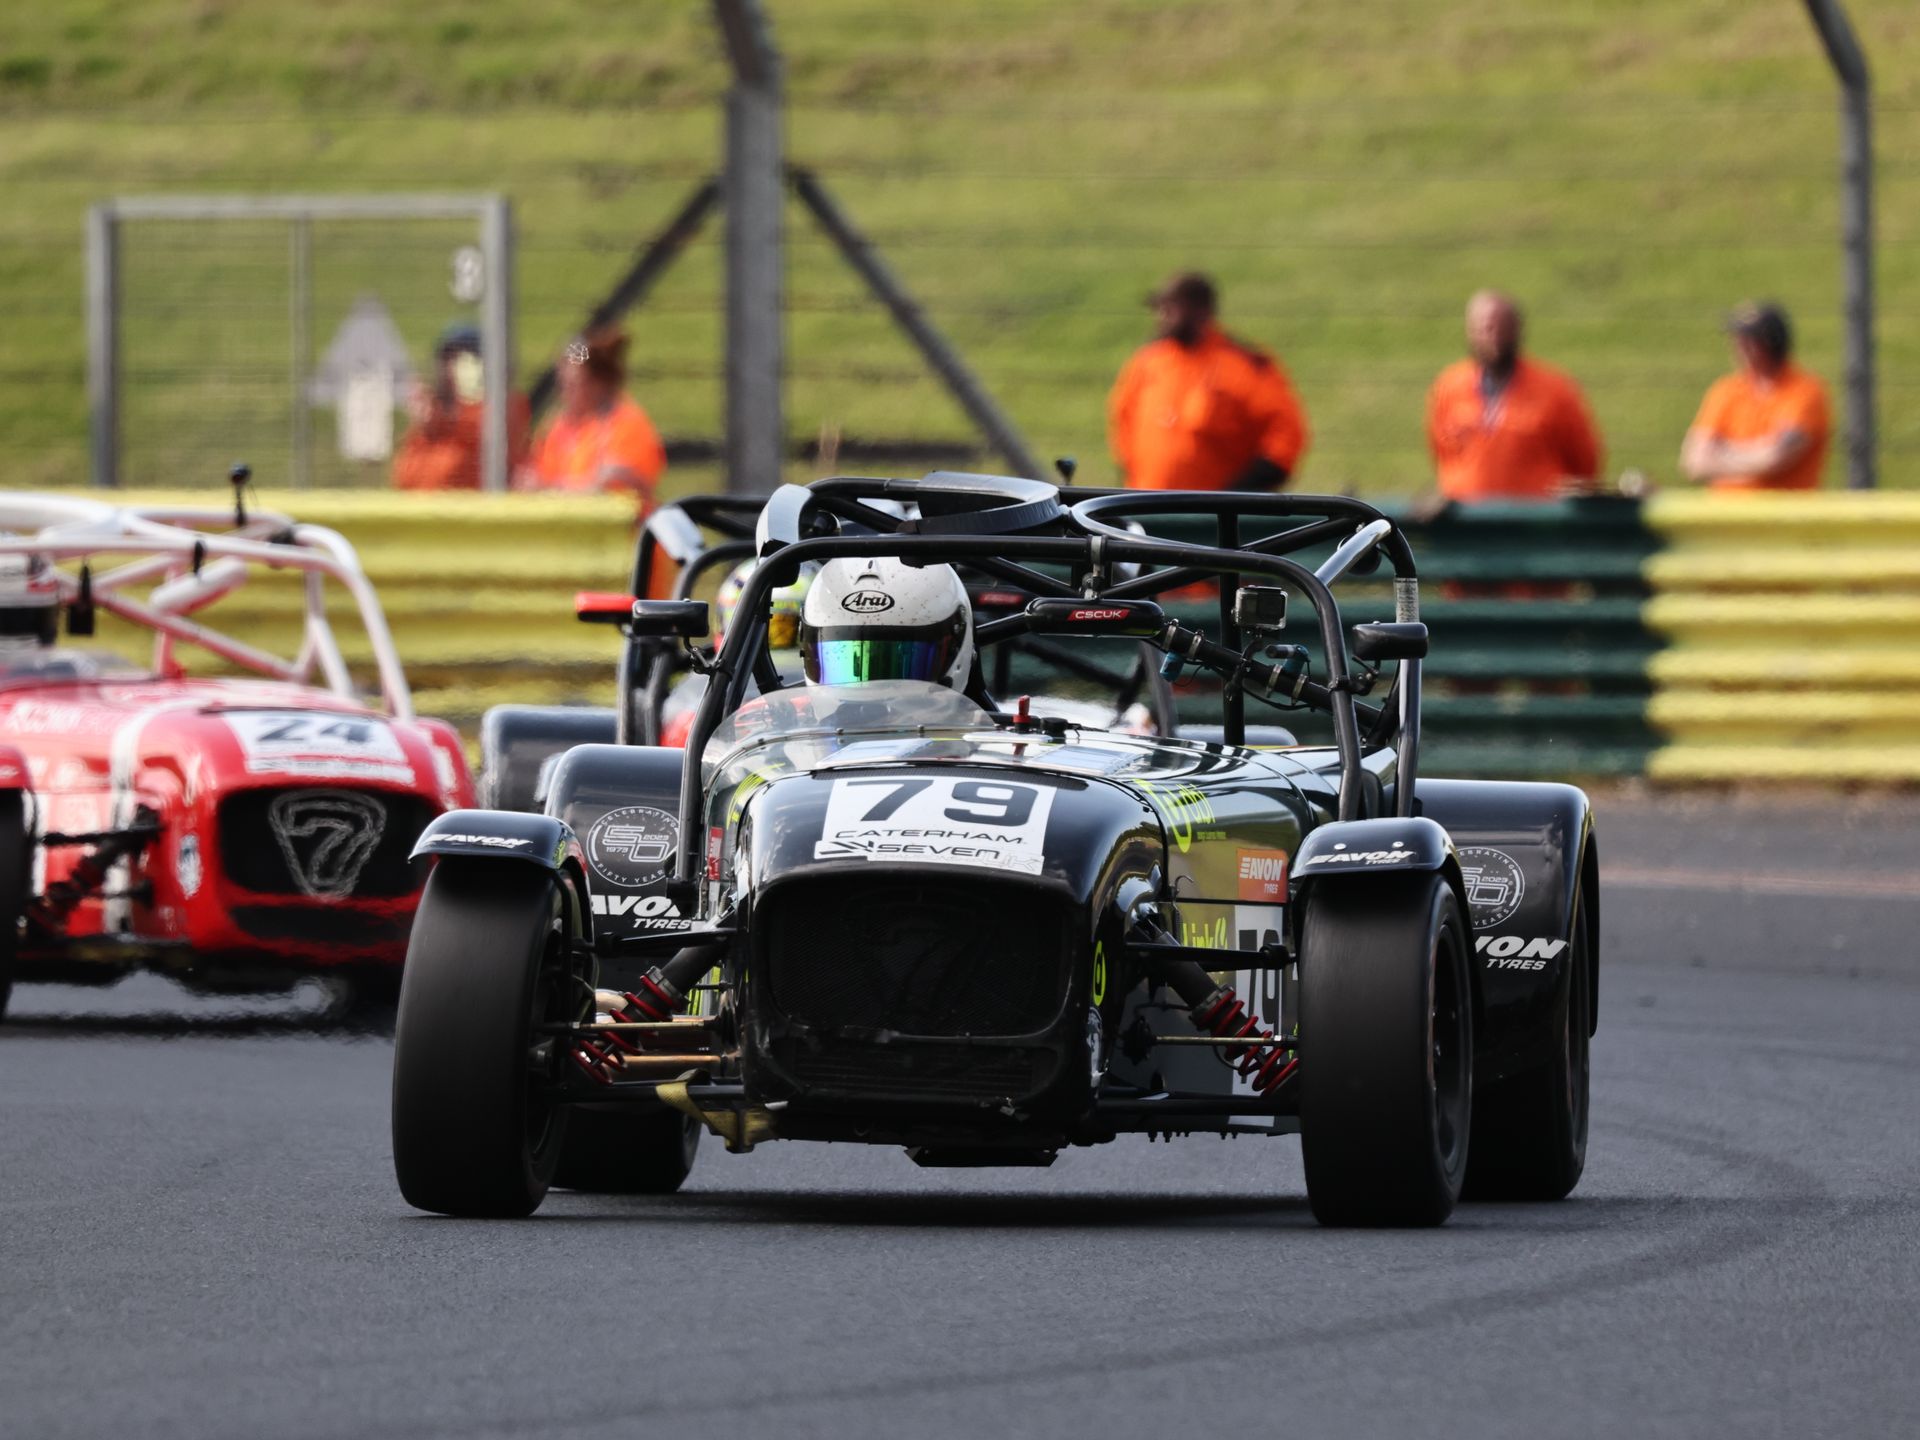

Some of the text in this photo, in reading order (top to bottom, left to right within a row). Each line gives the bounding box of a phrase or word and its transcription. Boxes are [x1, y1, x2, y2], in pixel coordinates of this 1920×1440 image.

[844, 592, 888, 607] Arai
[1074, 610, 1122, 620] CSCUK
[258, 717, 371, 744] 24
[846, 779, 1039, 827] 79
[601, 808, 677, 828] CELEBRATING
[444, 834, 534, 847] AVON
[602, 824, 670, 863] 50
[835, 829, 1026, 844] CATERHAM
[1328, 850, 1416, 862] AVON
[1459, 849, 1515, 870] EBRATING
[597, 863, 664, 883] FIFTY YEAR
[1248, 857, 1283, 882] AVON
[590, 895, 681, 917] AVO
[633, 918, 692, 930] TYRES
[1487, 958, 1547, 971] TYRES
